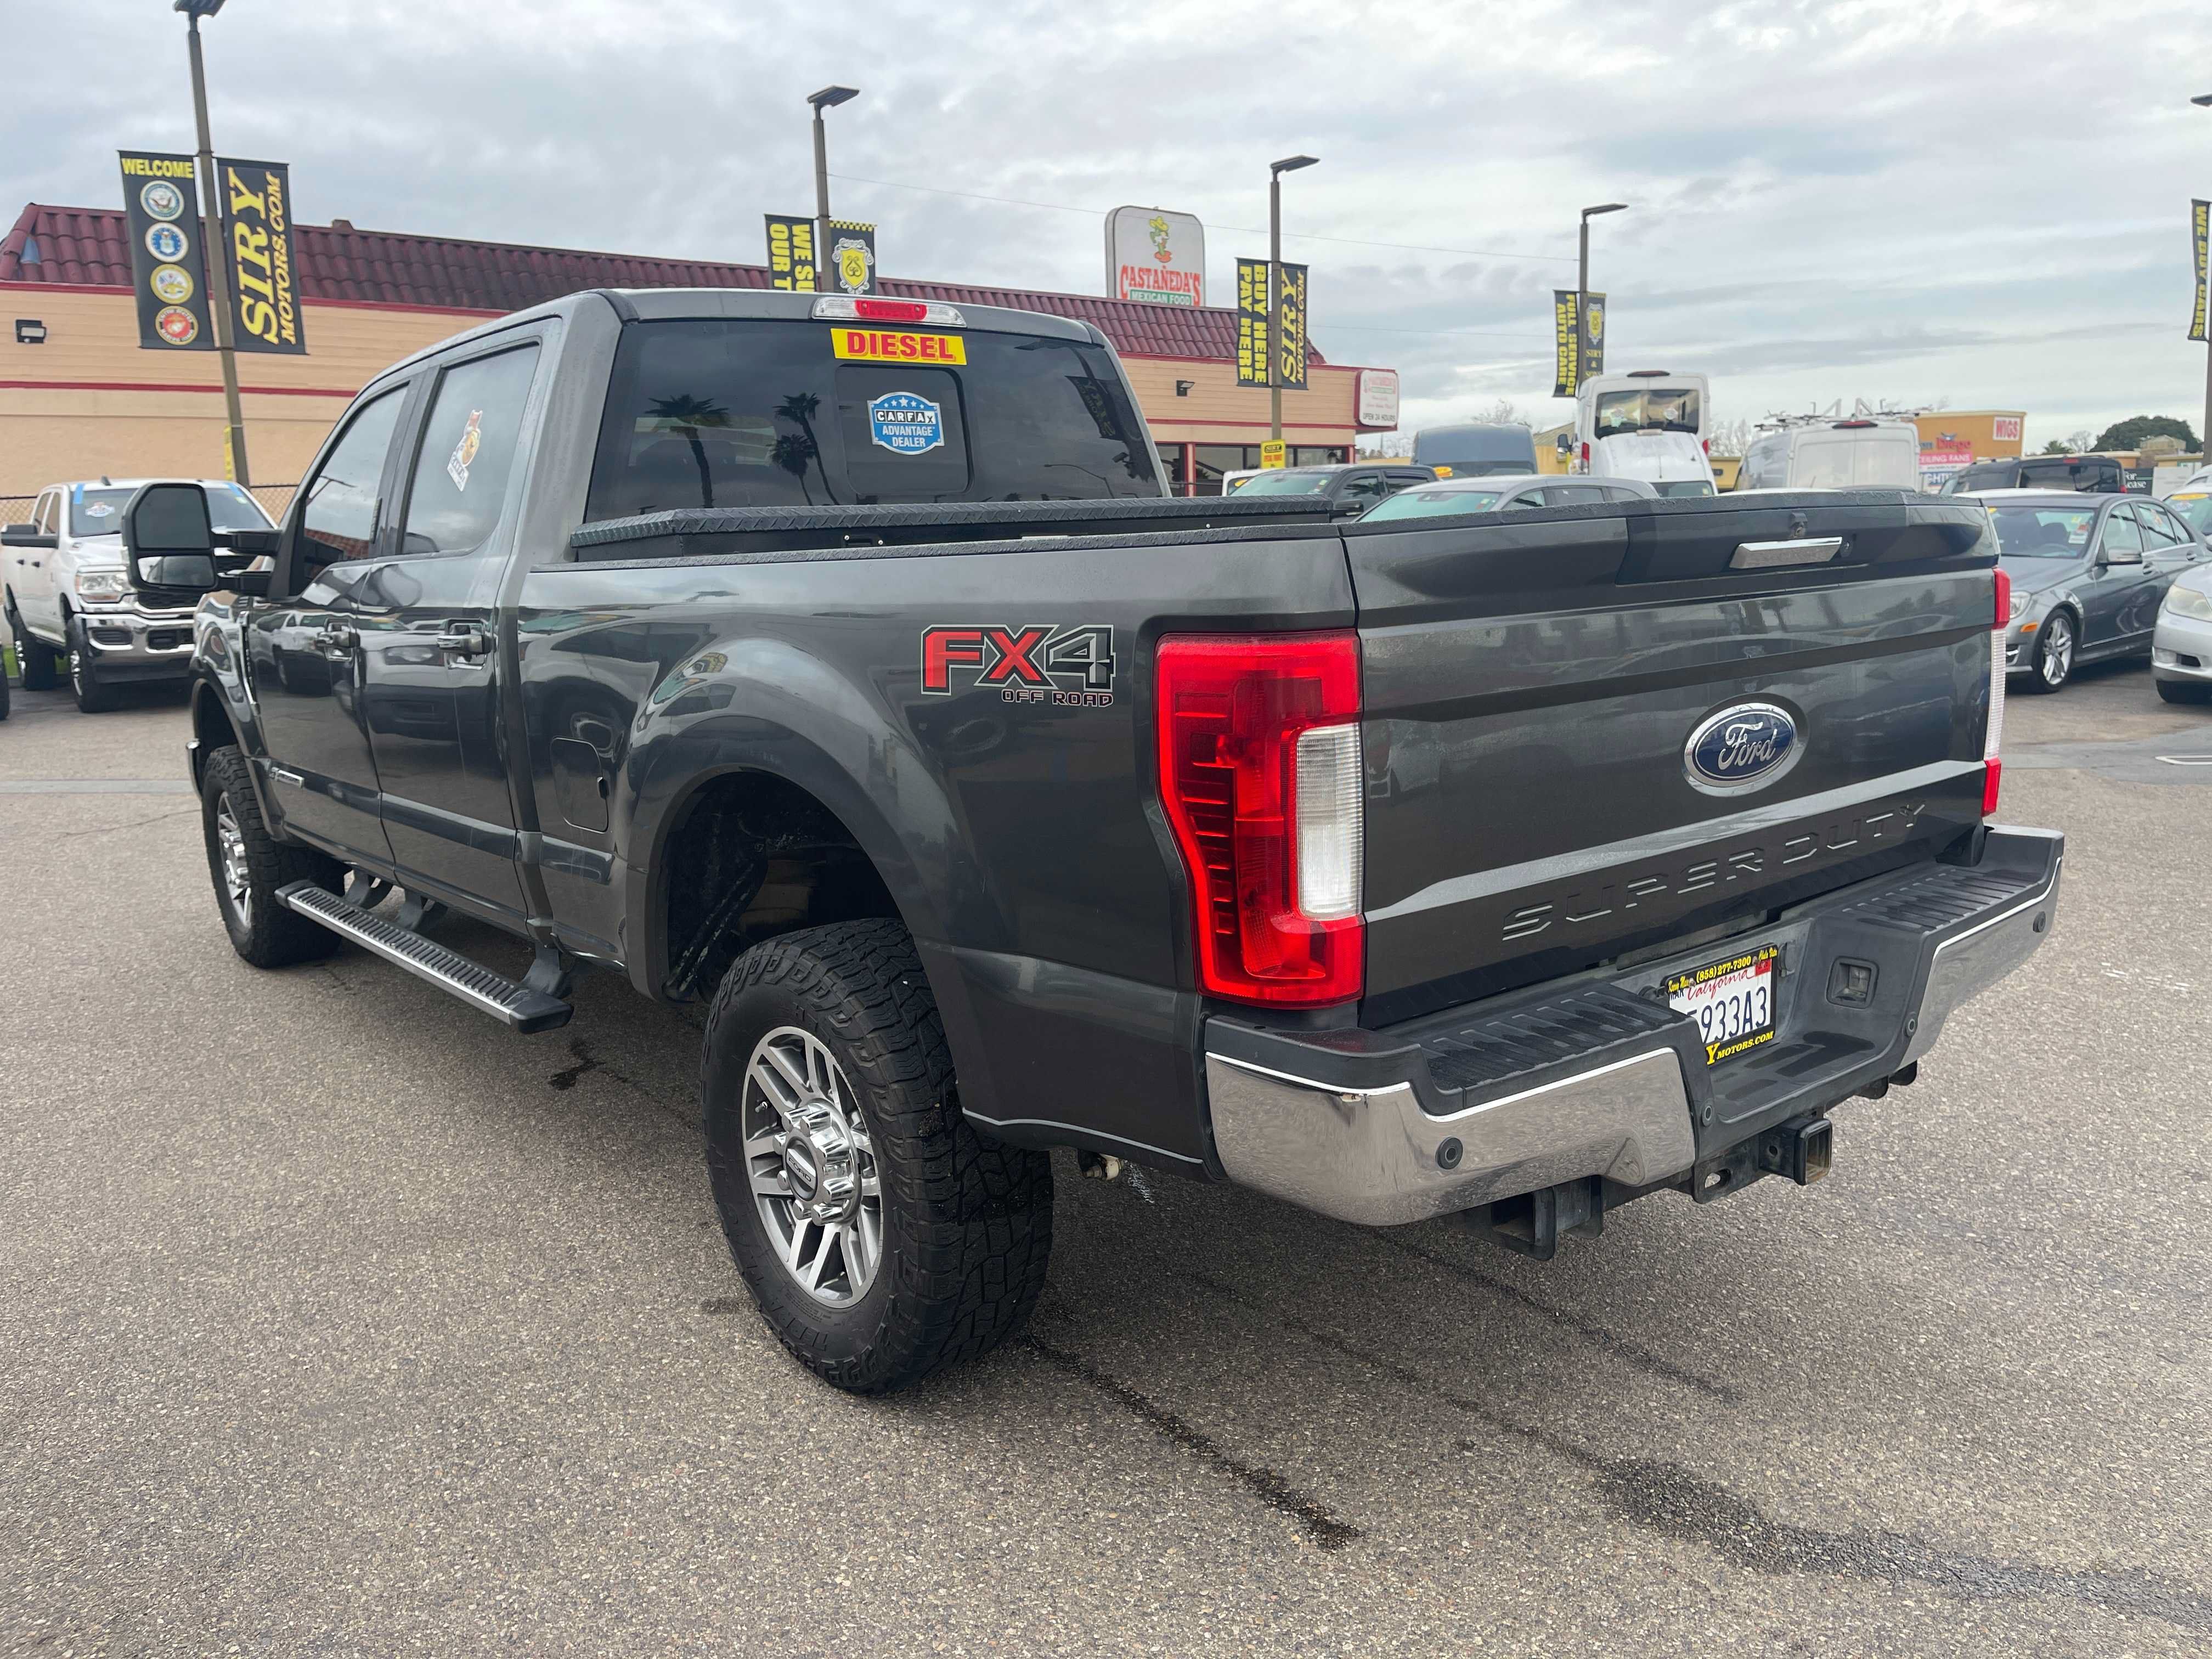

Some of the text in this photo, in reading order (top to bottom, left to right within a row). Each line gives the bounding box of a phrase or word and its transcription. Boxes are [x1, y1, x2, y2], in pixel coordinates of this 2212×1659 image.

[121, 157, 194, 179] WELCOME
[2196, 206, 2207, 236] WE
[228, 167, 279, 345] SIRY
[266, 171, 296, 345] MOTORS.COM
[769, 223, 791, 272] OUR
[791, 224, 812, 261] WE
[2198, 240, 2207, 280] BUY
[1131, 291, 1190, 305] MEXICAN FOOD
[1238, 266, 1253, 380] PAY HERE
[1253, 265, 1267, 383] BUY HERE
[1282, 268, 1297, 383] SIRY
[1557, 303, 1567, 343] AUTO
[847, 332, 956, 360] DIESEL
[876, 411, 936, 424] CARFAX
[882, 425, 933, 436] ADVANTAGE
[1995, 420, 2019, 439] WIGS
[892, 437, 926, 448] DEALER
[1948, 453, 1971, 462] FANS
[2125, 481, 2147, 489] ease
[921, 624, 1116, 696] FX4
[1001, 689, 1114, 708] OFF ROAD
[1718, 720, 1779, 771] Ford
[1502, 800, 1926, 941] SUPER DUTY
[1687, 968, 1755, 1001] California
[1696, 966, 1717, 984] (858)
[1717, 956, 1751, 975] 277-7300
[1687, 986, 1767, 1043] 933A3
[788, 1156, 812, 1182] FORD
